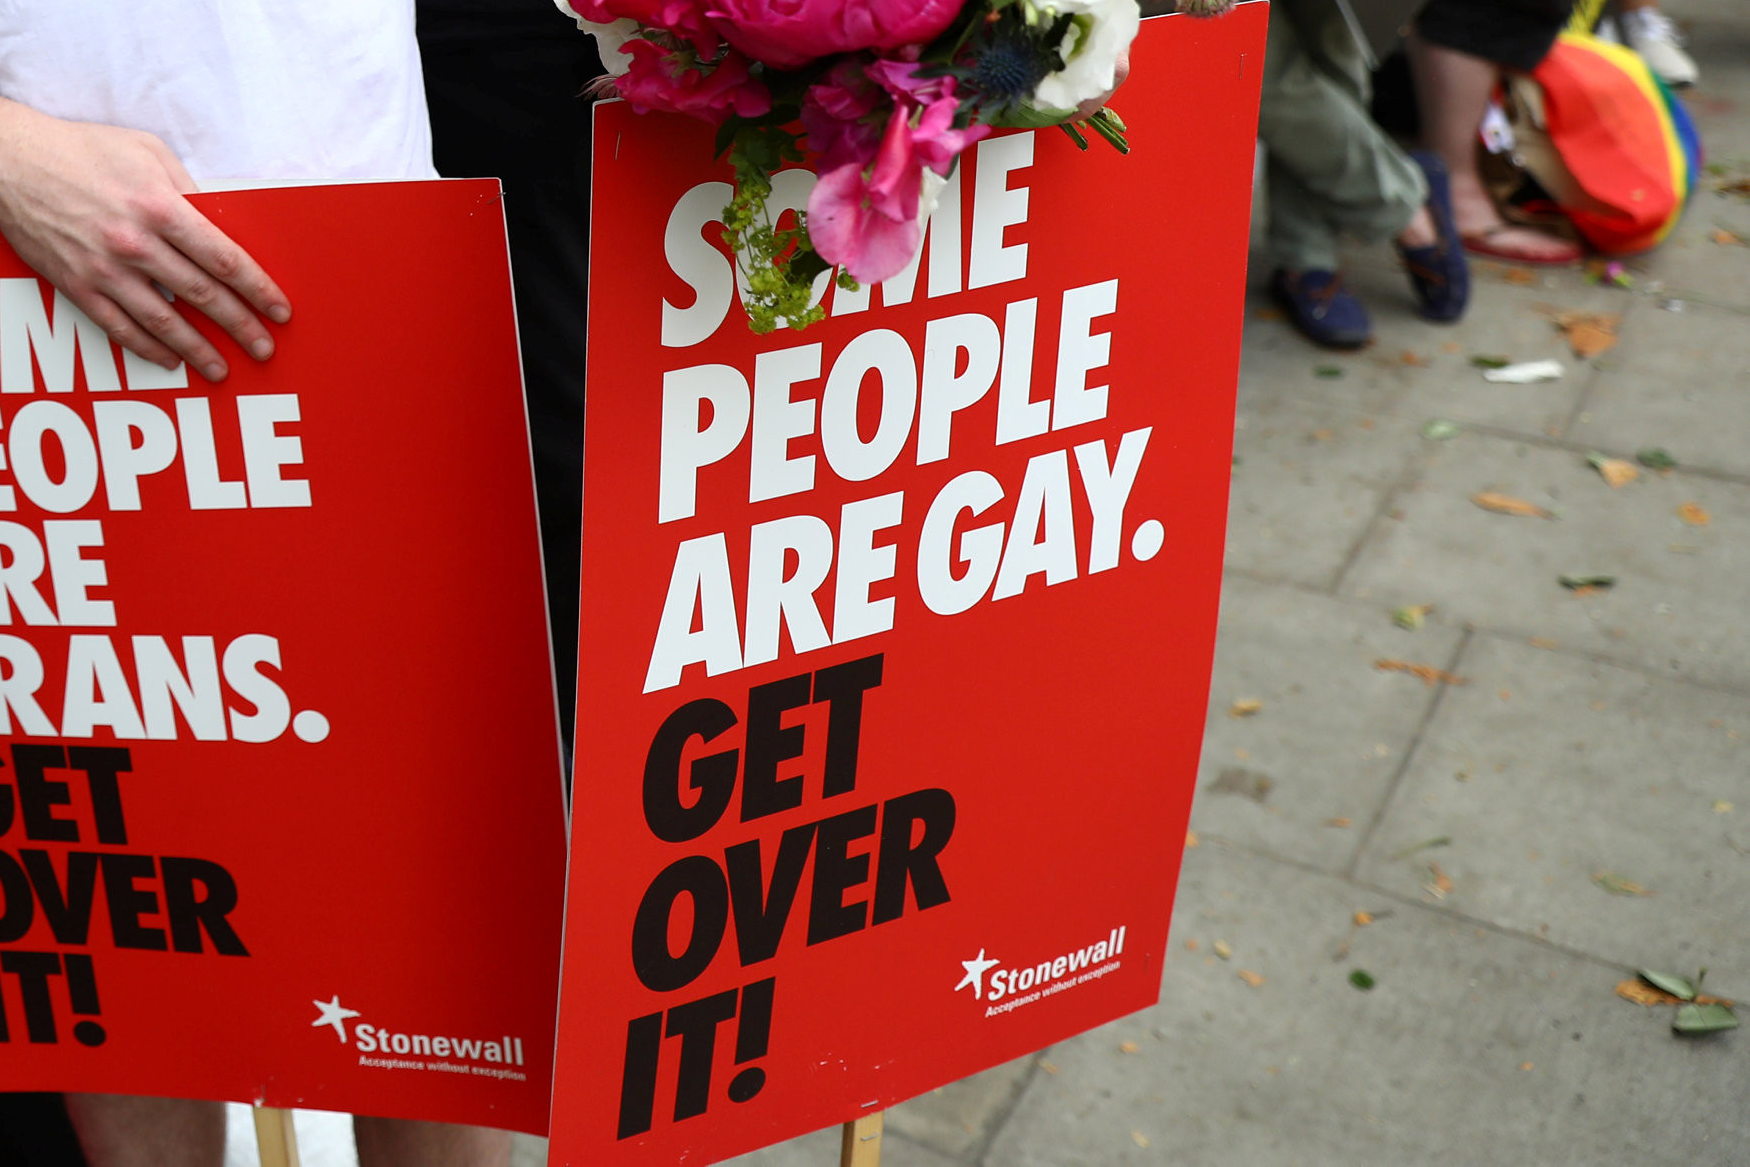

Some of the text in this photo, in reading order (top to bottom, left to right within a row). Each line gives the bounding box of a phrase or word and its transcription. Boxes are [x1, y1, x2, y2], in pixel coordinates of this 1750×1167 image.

[657, 278, 1120, 525] PEOPLE
[641, 425, 1166, 695] ARE GAY.
[642, 652, 886, 843] GET
[631, 787, 957, 993] OVER
[987, 925, 1126, 1002] Stonewall
[354, 1023, 524, 1066] Stonewall
[358, 1054, 527, 1082] Acceptance without exception
[617, 975, 777, 1141] IT!
[984, 960, 1122, 1018] Acceptance without exception
